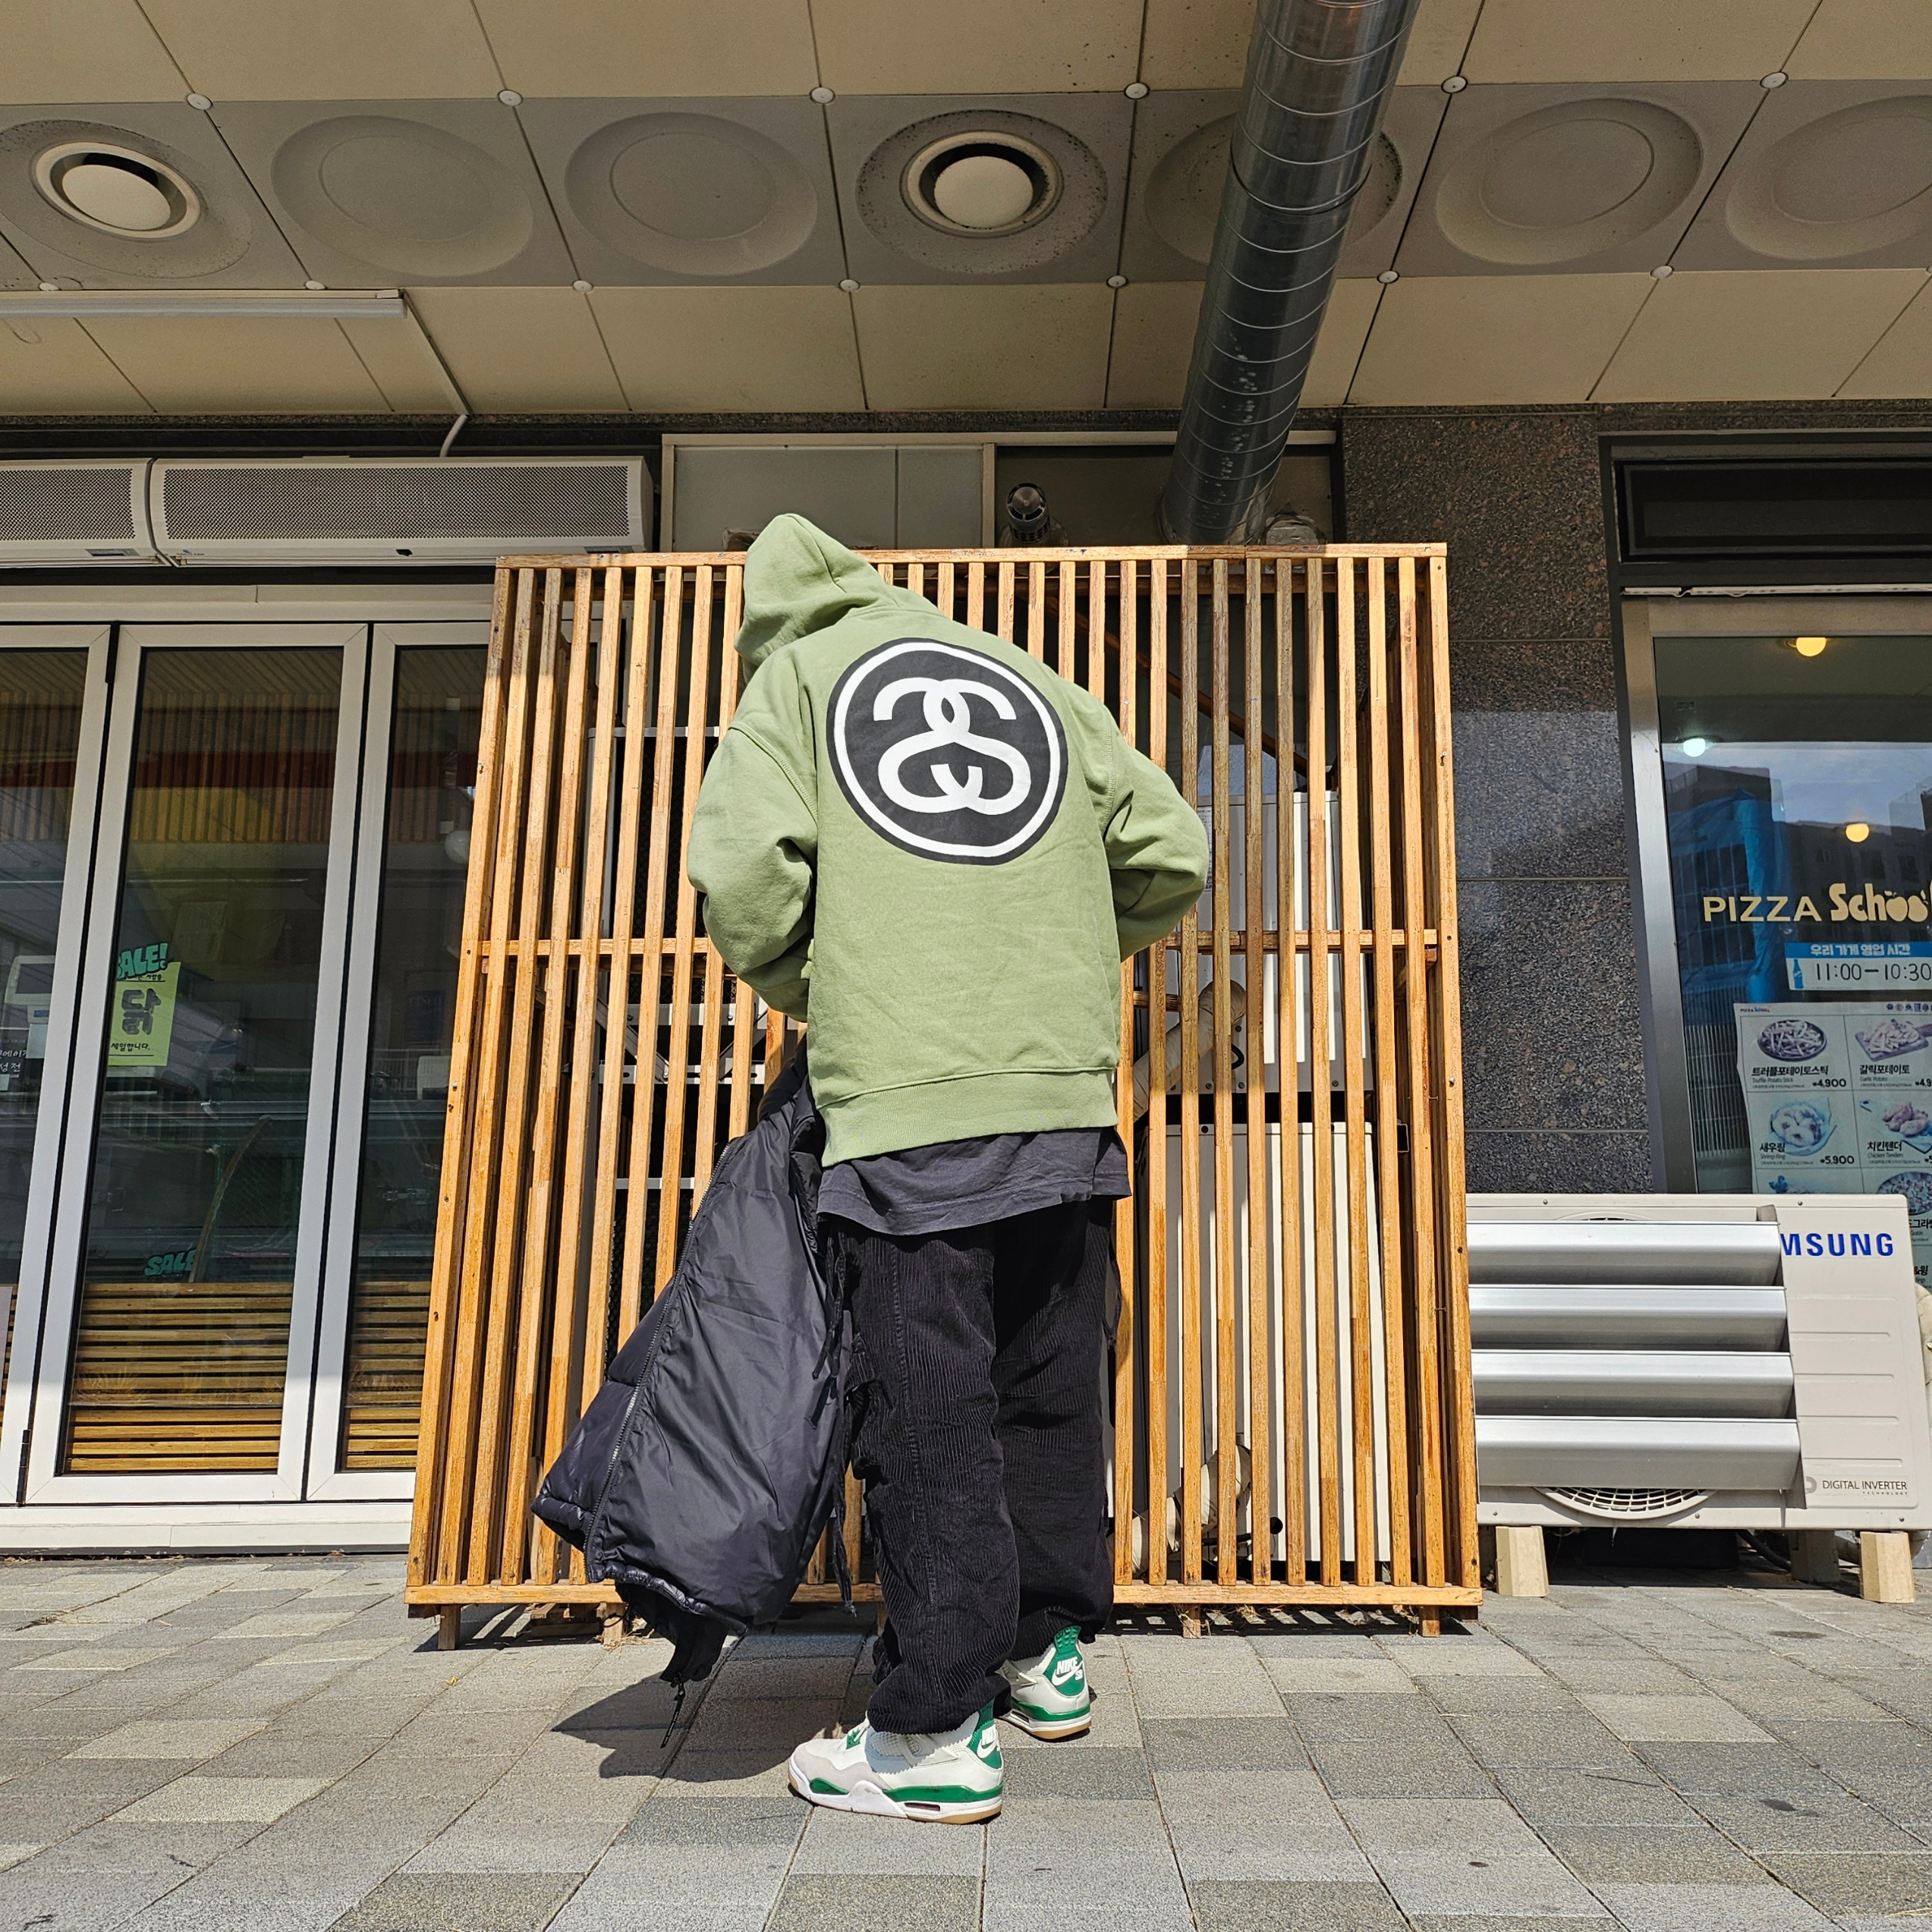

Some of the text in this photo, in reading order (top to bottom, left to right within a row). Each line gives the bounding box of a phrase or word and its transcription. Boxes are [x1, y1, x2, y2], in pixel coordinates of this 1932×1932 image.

[1703, 880, 1932, 923] PIZZA Schoo
[1811, 944, 1911, 956] 우리 가게 영업 시간
[1859, 1064, 1910, 1075] 갈릭포테이토
[1759, 1142, 1786, 1153] 새우링
[1867, 1141, 1902, 1152] 치킨텐더
[1779, 1232, 1893, 1257] MSUNG
[1822, 1480, 1907, 1490] DIGITAL INVERTER
[1056, 1656, 1078, 1675] NIKE
